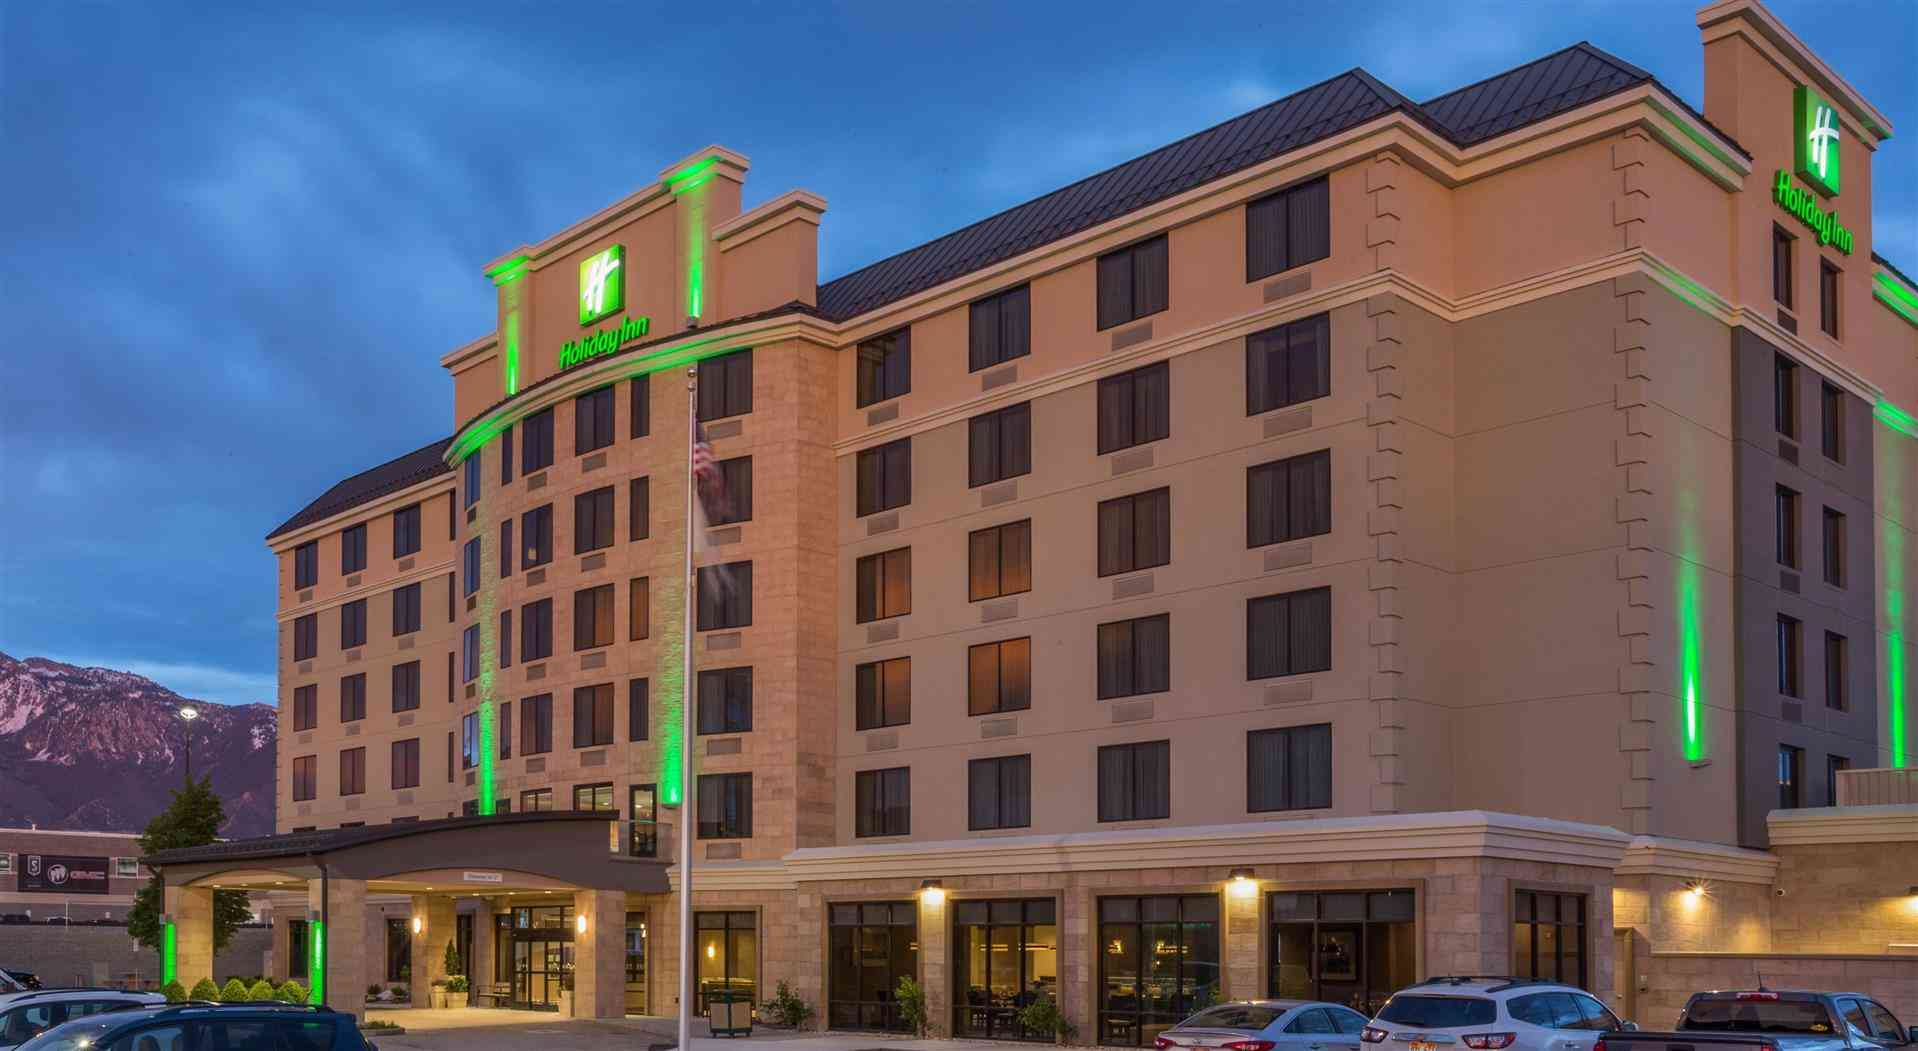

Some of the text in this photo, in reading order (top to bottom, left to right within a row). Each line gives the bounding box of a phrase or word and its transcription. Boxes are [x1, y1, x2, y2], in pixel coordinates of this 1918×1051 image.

[1774, 169, 1854, 256] Holiday Inn
[559, 316, 650, 369] Holiday Inn
